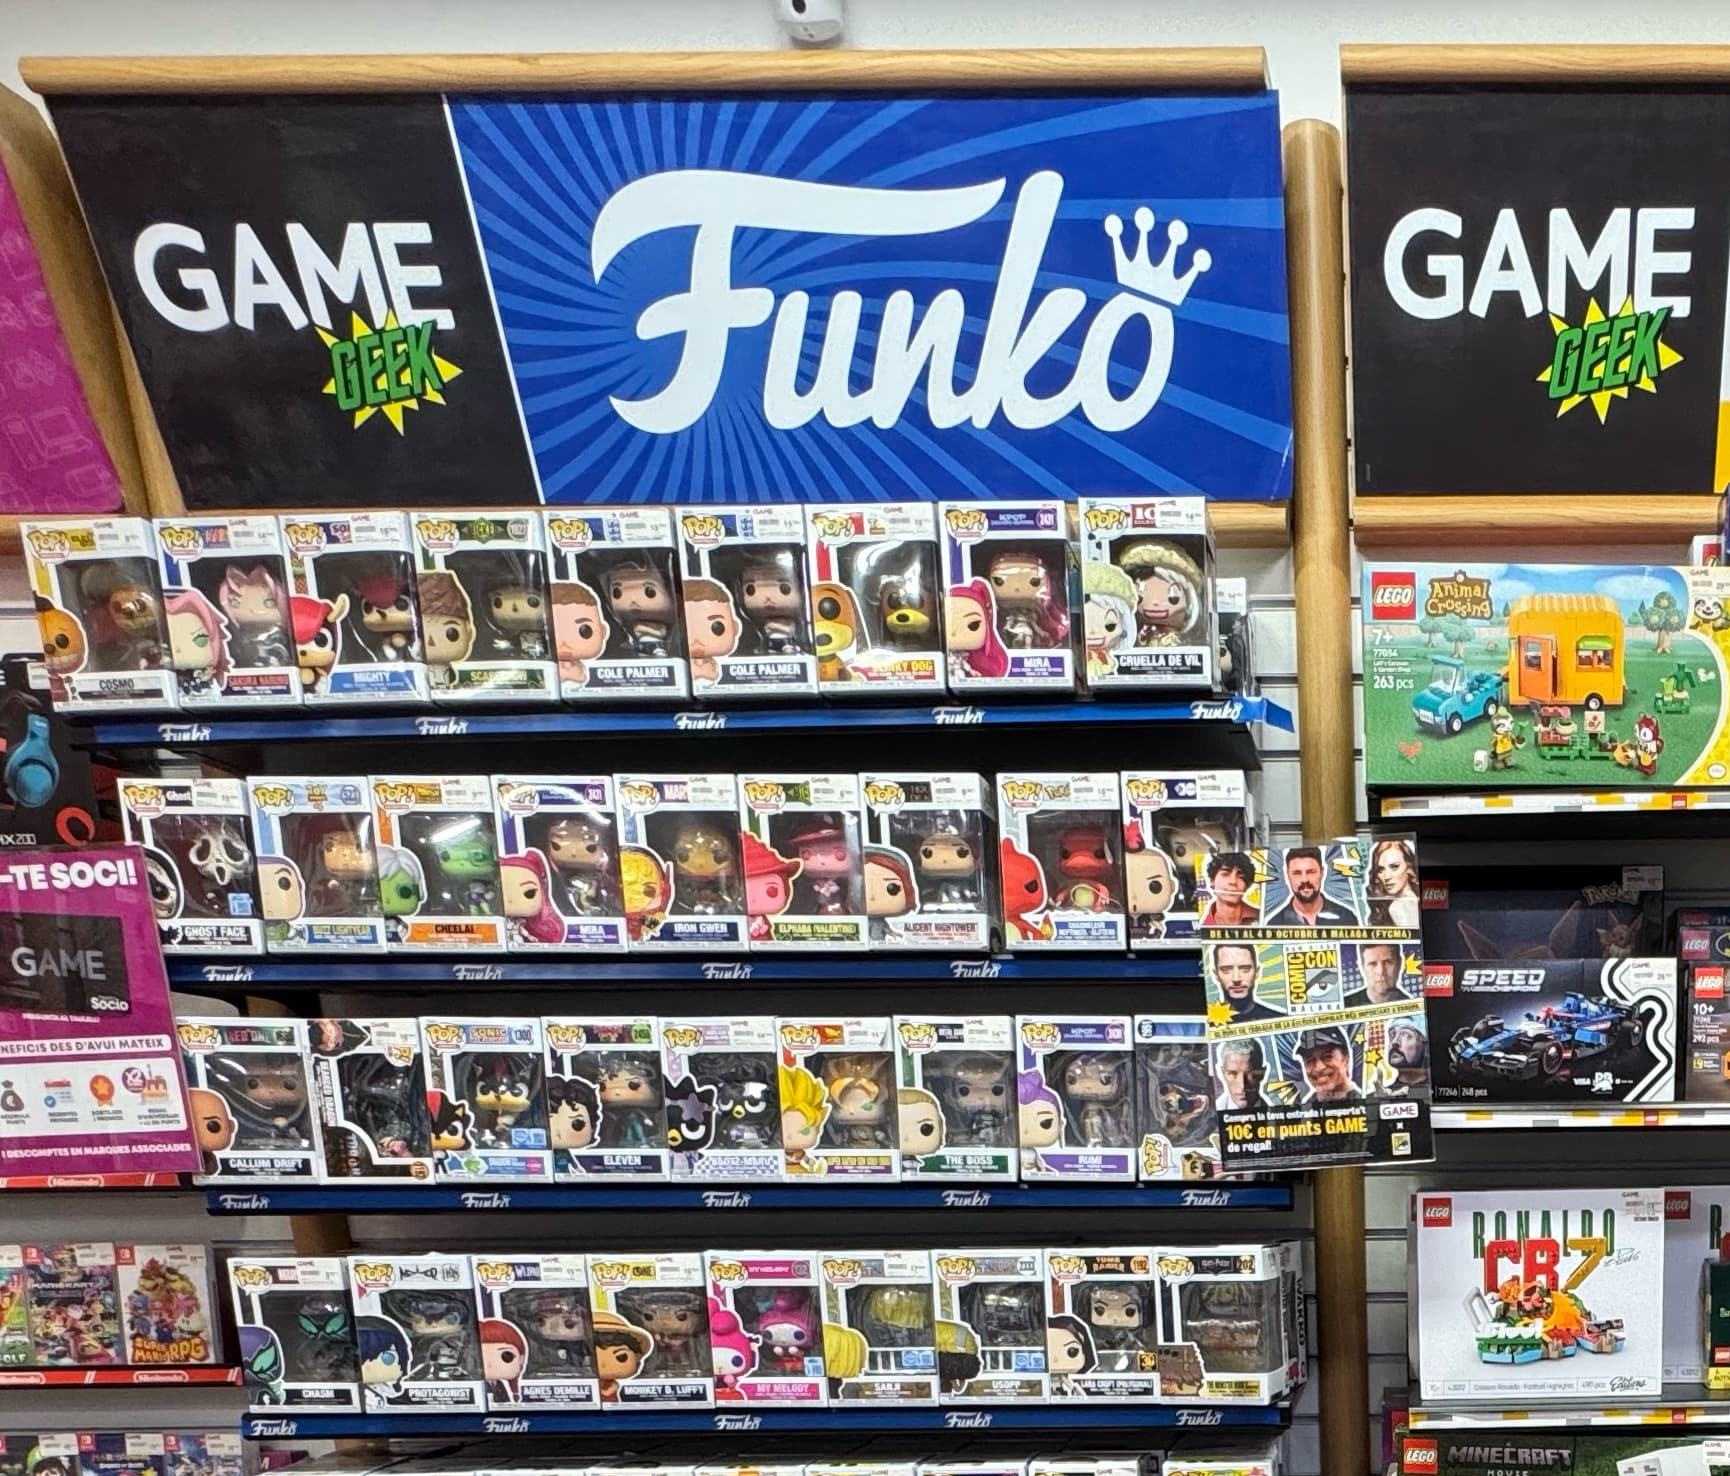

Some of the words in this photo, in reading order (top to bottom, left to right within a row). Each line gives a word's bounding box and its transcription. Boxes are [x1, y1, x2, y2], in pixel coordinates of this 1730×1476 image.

[1383, 207, 1694, 320] GAME
[133, 220, 454, 333] GAME
[592, 169, 1178, 434] Funko
[1548, 308, 1668, 402] GEEK
[331, 319, 443, 410] GEEK
[27, 528, 68, 552] POP!
[1374, 584, 1413, 606] LEGO
[1433, 580, 1488, 600] Animal
[1426, 599, 1490, 618] Crossing
[1023, 657, 1050, 670] MIRA
[1119, 654, 1162, 667] CRUELLA
[1165, 654, 1178, 666] DE
[1181, 653, 1201, 666] VIL
[353, 670, 390, 683] MIGHTY
[597, 668, 625, 680] COLE
[627, 666, 669, 678] PALMER
[729, 664, 756, 676] COLE
[759, 663, 801, 675] PALMER
[98, 678, 134, 692] COSMO
[1372, 675, 1394, 689] 263
[1397, 677, 1414, 690] pcs
[932, 706, 985, 724] Funko
[1190, 700, 1234, 719] Funko
[57, 860, 138, 888] SOCI!
[184, 925, 212, 937] GHOST
[215, 925, 246, 936] FACE
[580, 924, 604, 935] MIRA
[12, 947, 106, 980] GAME
[1306, 952, 1336, 968] CON
[1290, 953, 1306, 1004] COMIC
[1427, 974, 1451, 987] LEGO
[1461, 969, 1545, 986] SPEED
[1696, 975, 1722, 990] LEGO
[91, 998, 128, 1011] Socio
[1693, 1004, 1715, 1015] 10+
[1462, 1088, 1473, 1096] 248
[1475, 1089, 1487, 1098] pcs
[1382, 1106, 1416, 1117] GAME
[1225, 1126, 1253, 1140] 10€
[1257, 1127, 1274, 1138] en
[1280, 1123, 1321, 1139] punts
[1326, 1119, 1367, 1134] GAME
[228, 1159, 265, 1169] CALLUM
[270, 1158, 302, 1168] DRIFT
[604, 1155, 641, 1166] ELEVEN
[945, 1156, 963, 1166] THE
[966, 1155, 993, 1166] BOSS
[218, 1194, 264, 1209] Funko
[941, 1190, 986, 1206] Funko
[1424, 1206, 1450, 1219] LEGO
[1473, 1208, 1616, 1259] RONALDO
[135, 1339, 169, 1351] SUPER
[170, 1339, 205, 1360] RPG
[134, 1349, 169, 1362] MARIO
[302, 1390, 334, 1398] CHASM
[755, 1384, 769, 1394] MY
[772, 1384, 809, 1394] MELODY
[250, 1420, 292, 1436] Funko
[1405, 1450, 1434, 1463] LEGO
[1447, 1446, 1571, 1470] MINECRAFT
